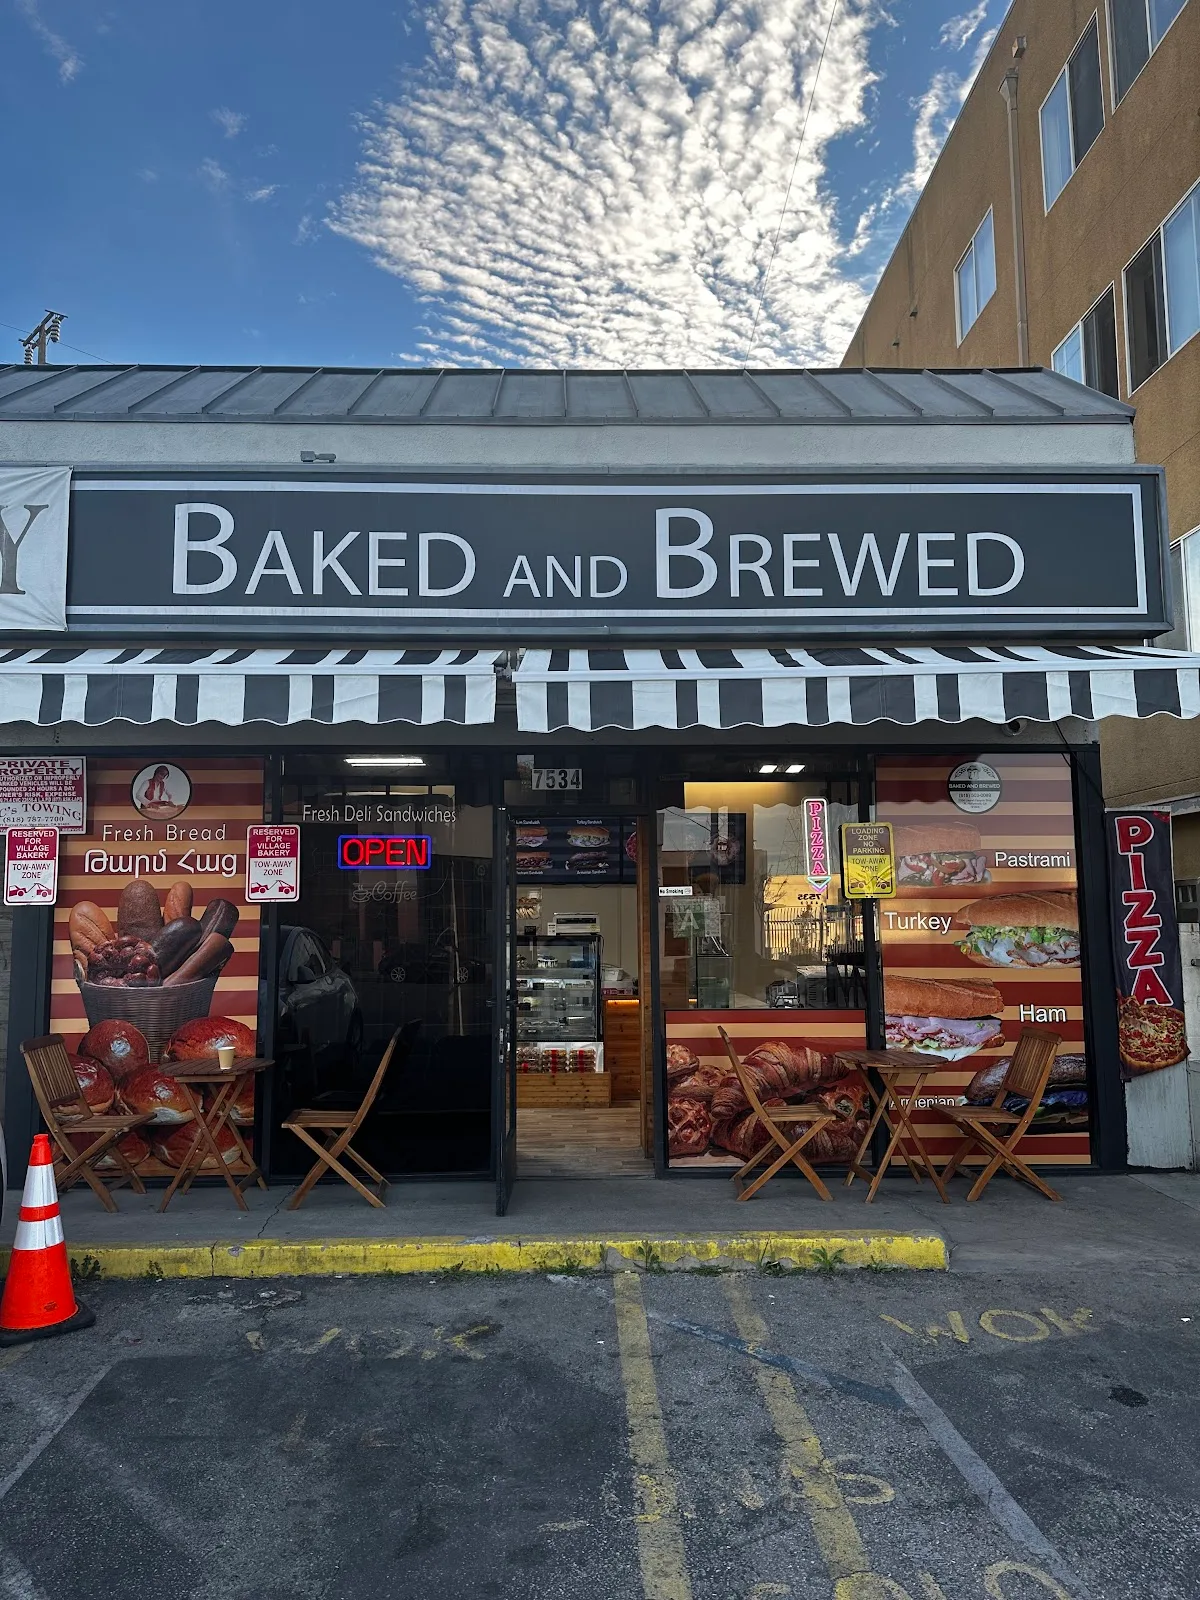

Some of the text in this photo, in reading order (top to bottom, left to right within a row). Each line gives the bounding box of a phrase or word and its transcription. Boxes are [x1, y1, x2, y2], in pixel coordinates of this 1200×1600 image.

[172, 502, 1025, 599] BAKED AND BREWED
[0, 767, 80, 775] ROPERTY
[533, 769, 581, 789] 7534
[22, 803, 81, 821] TOWING
[302, 804, 457, 823] Fresh Deli Sandwiches
[102, 823, 226, 841] Fresh Bread
[809, 802, 827, 875] PIZZA
[16, 844, 50, 852] VILLAGE
[257, 842, 291, 850] VILLAGE
[257, 849, 290, 857] BAKERY
[342, 838, 427, 866] OPEN
[84, 848, 237, 879] Թարմ Հաց
[995, 852, 1071, 867] Pastrami
[22, 871, 41, 879] ZONE
[372, 881, 417, 904] Coffee
[1115, 816, 1174, 1006] PIZZA
[884, 912, 952, 934] Turkey
[1020, 1004, 1066, 1022] Ham
